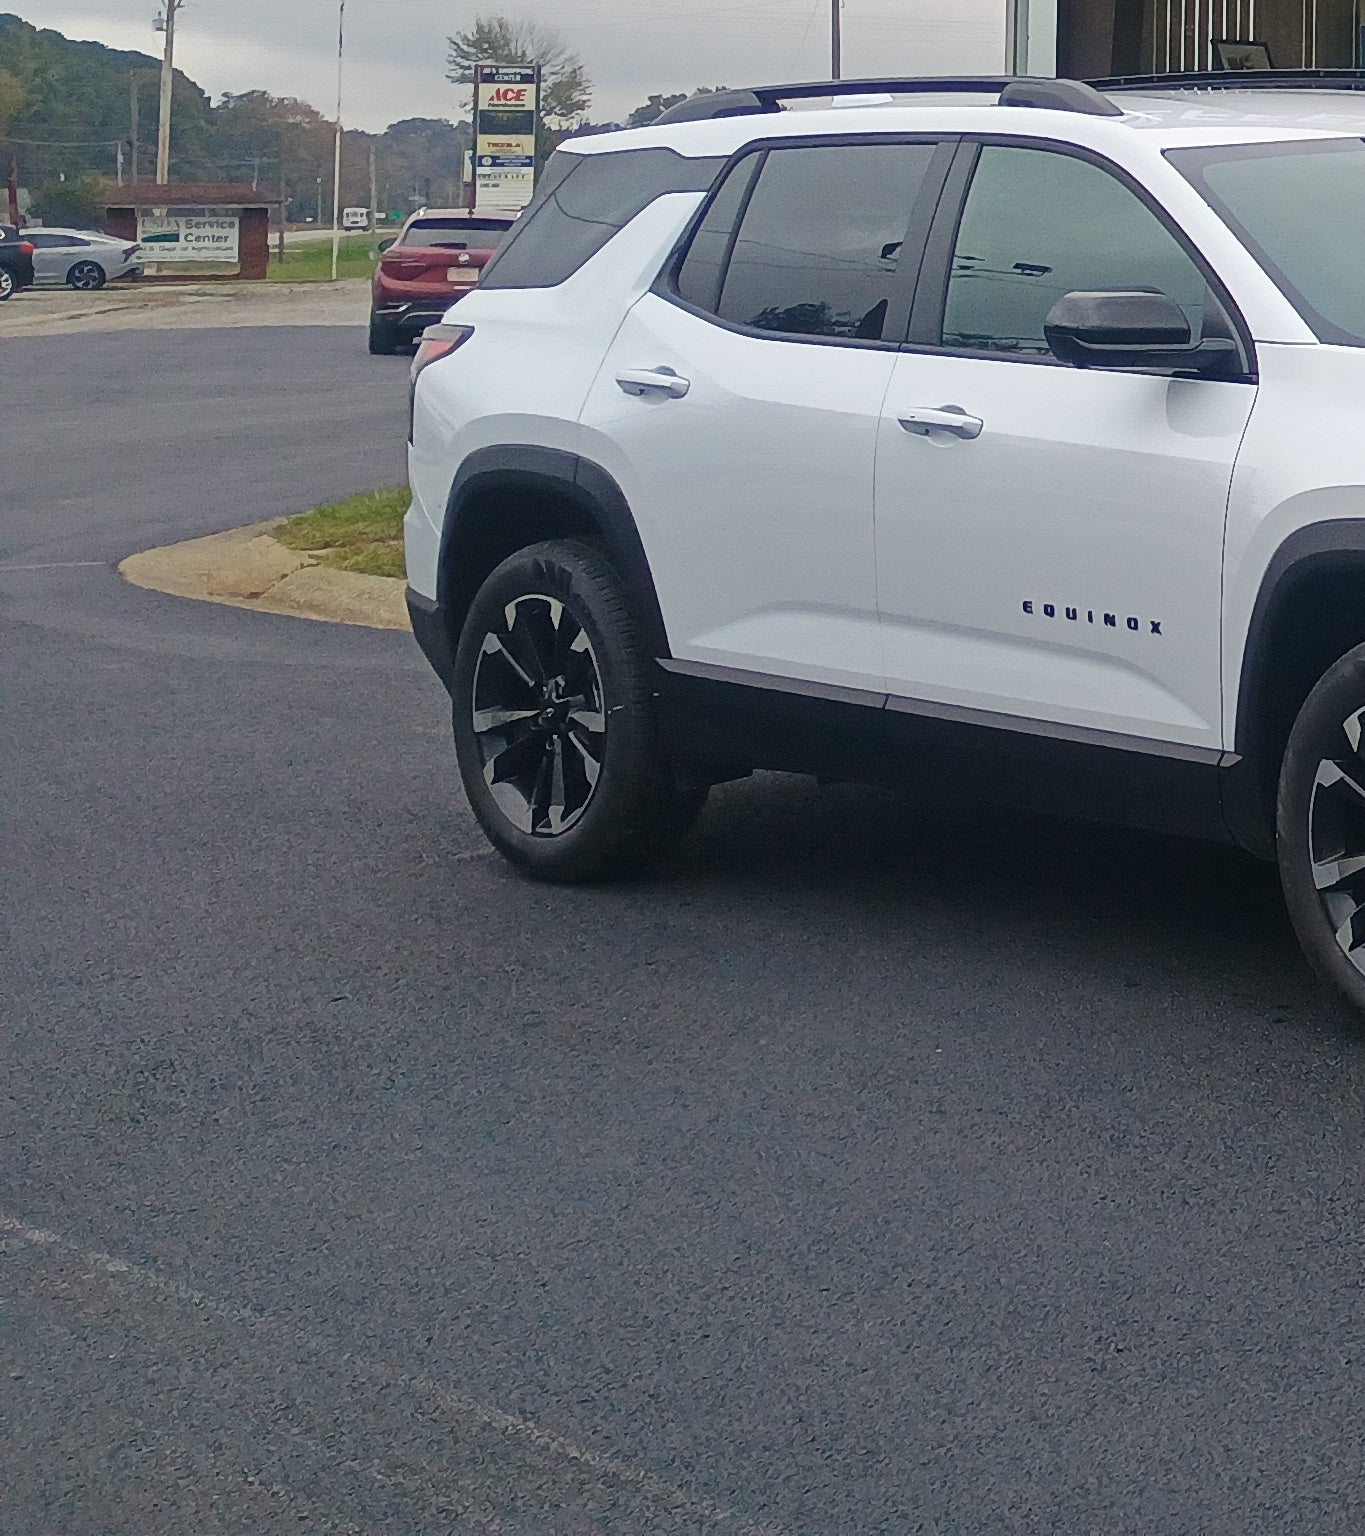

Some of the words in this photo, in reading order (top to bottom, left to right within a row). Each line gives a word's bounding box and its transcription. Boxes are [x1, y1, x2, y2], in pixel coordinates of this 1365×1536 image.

[488, 87, 527, 101] ACE
[184, 219, 236, 229] Service
[184, 233, 229, 243] Center
[1022, 600, 1162, 635] EQUINOX
